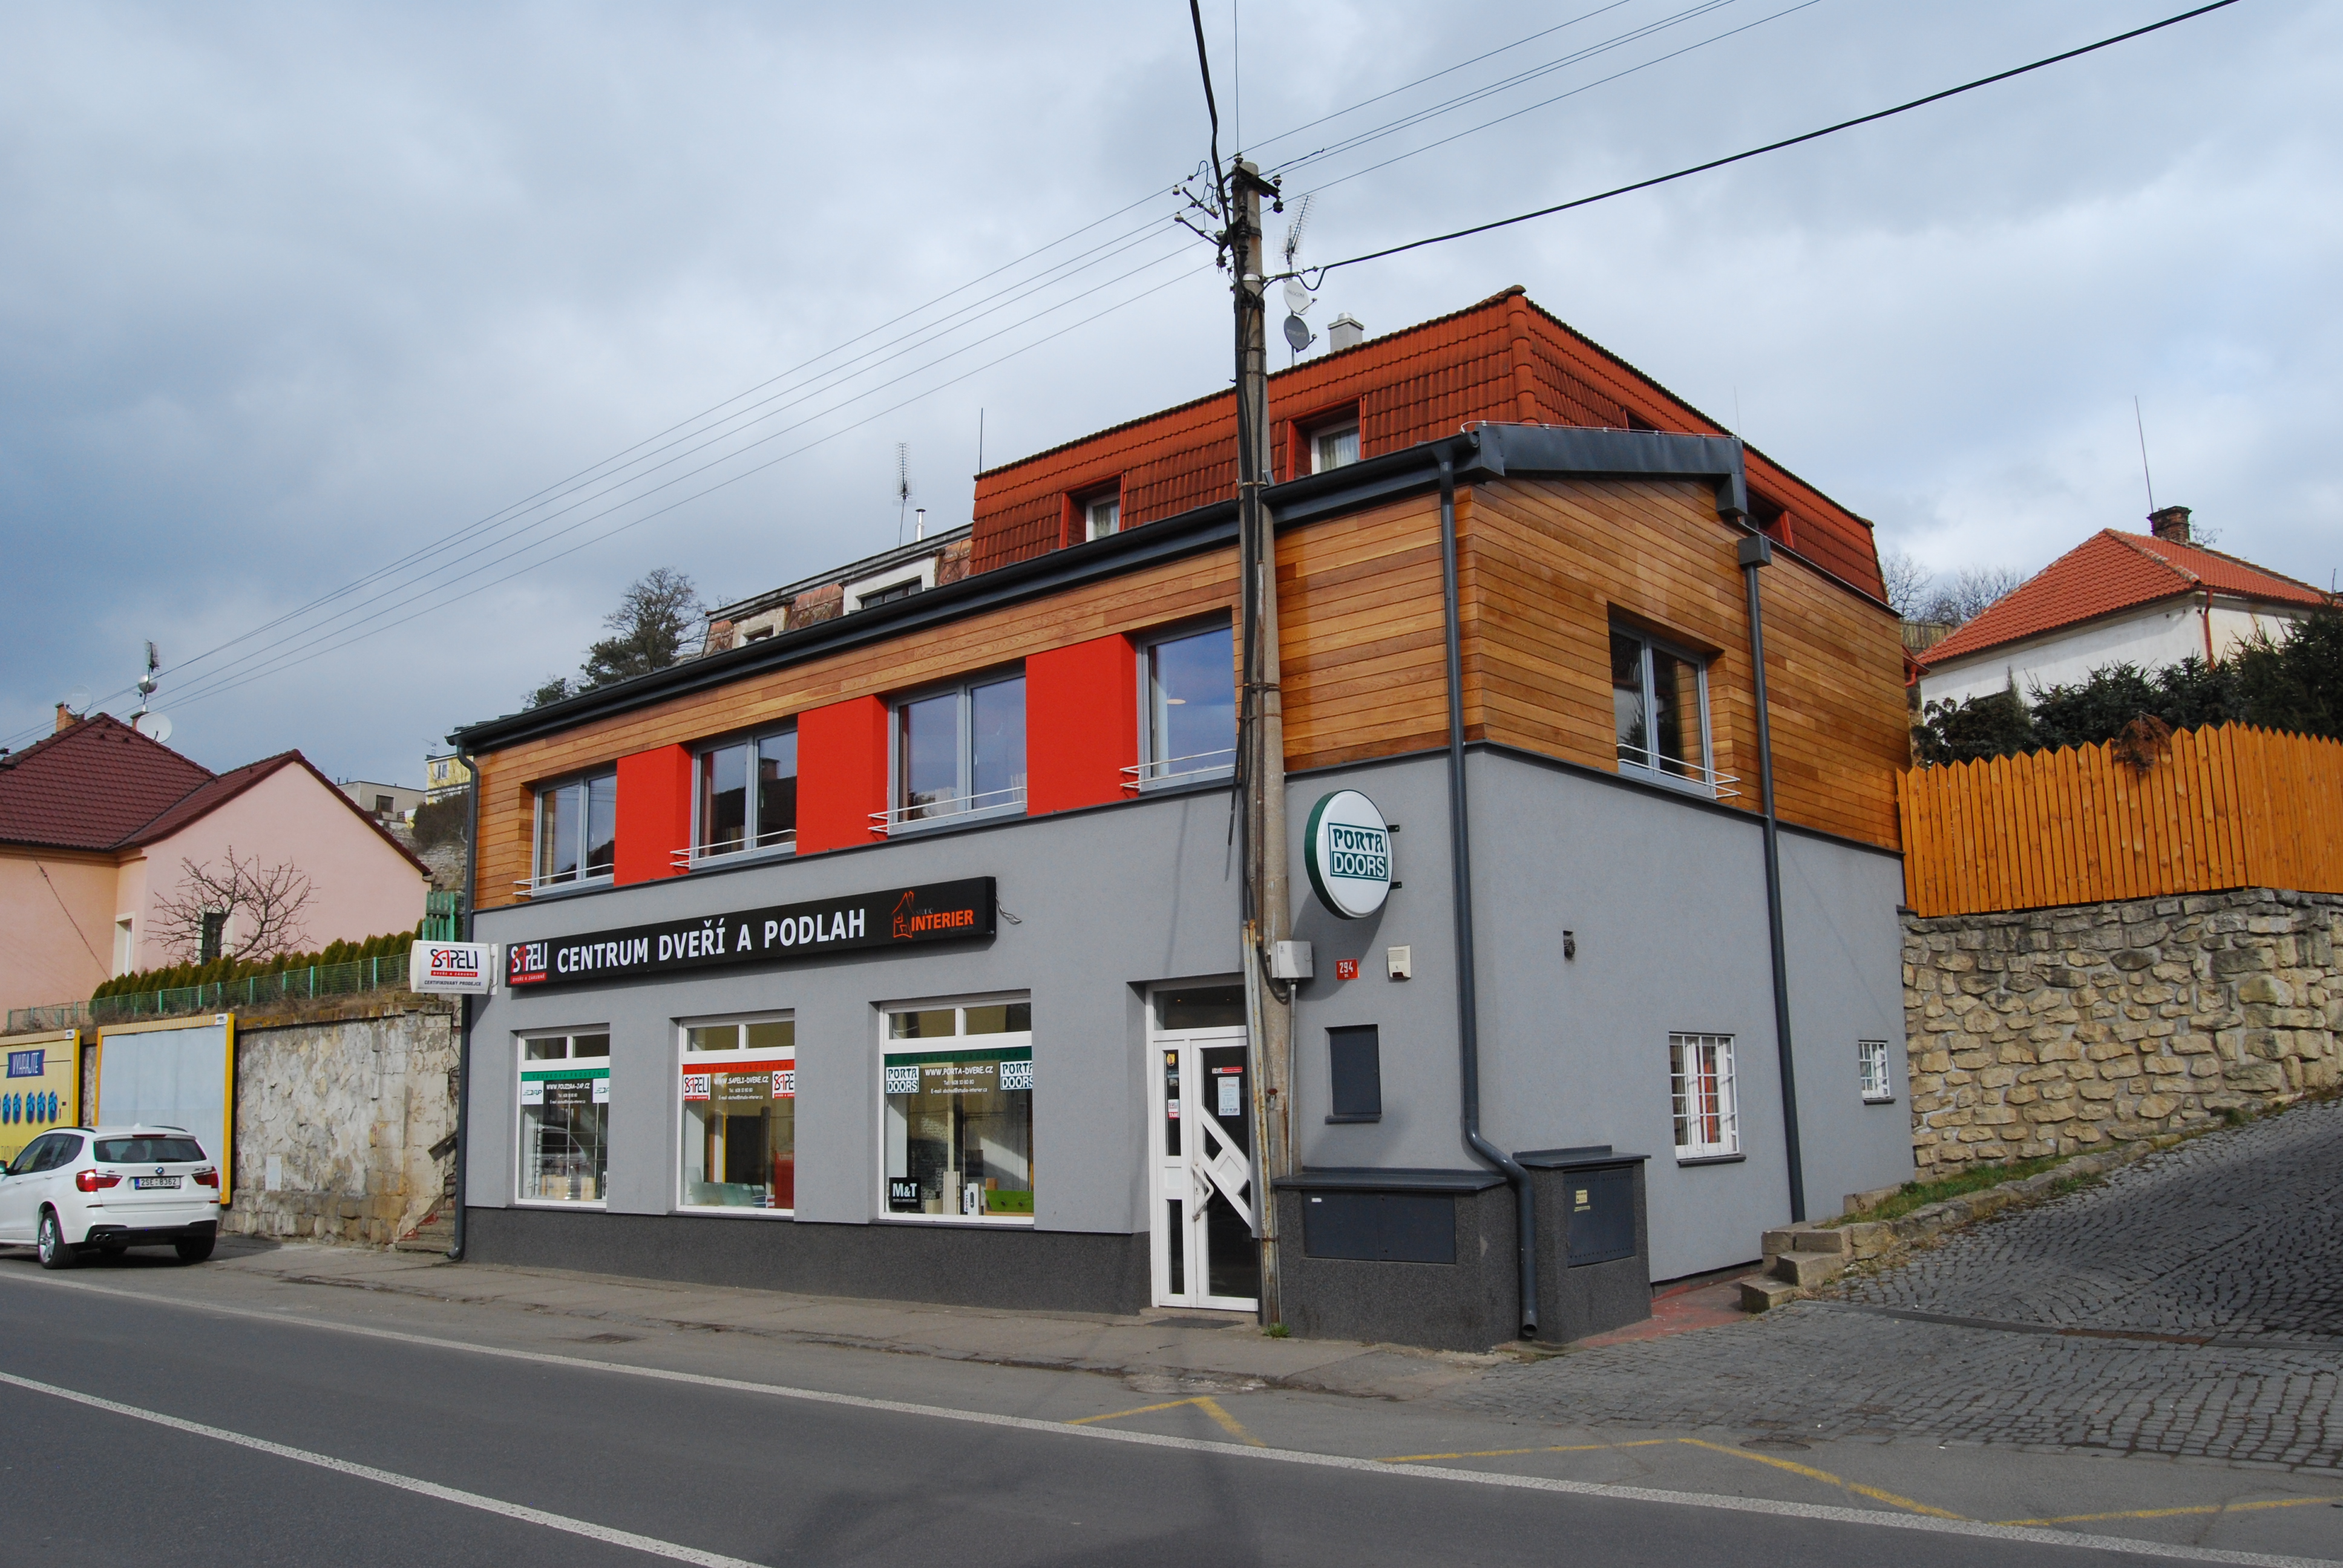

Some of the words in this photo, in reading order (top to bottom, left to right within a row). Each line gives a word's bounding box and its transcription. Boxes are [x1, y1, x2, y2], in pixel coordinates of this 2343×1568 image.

[1332, 828, 1384, 853] PORTA
[1334, 852, 1385, 877] DOORS
[911, 909, 974, 932] INTERIER
[557, 937, 648, 973] CENTRUM
[658, 918, 726, 961] DVEŘÍ
[736, 924, 752, 952] A
[764, 908, 865, 949] PODLAH
[430, 949, 478, 970] SAPELI
[511, 942, 548, 973] SAPELI
[1339, 961, 1354, 973] 294
[888, 1068, 917, 1079] PORTA
[1002, 1076, 1032, 1088] DOORS
[684, 1077, 709, 1093] SAPELI
[888, 1080, 918, 1092] DOORS
[893, 1183, 917, 1197] M&T
